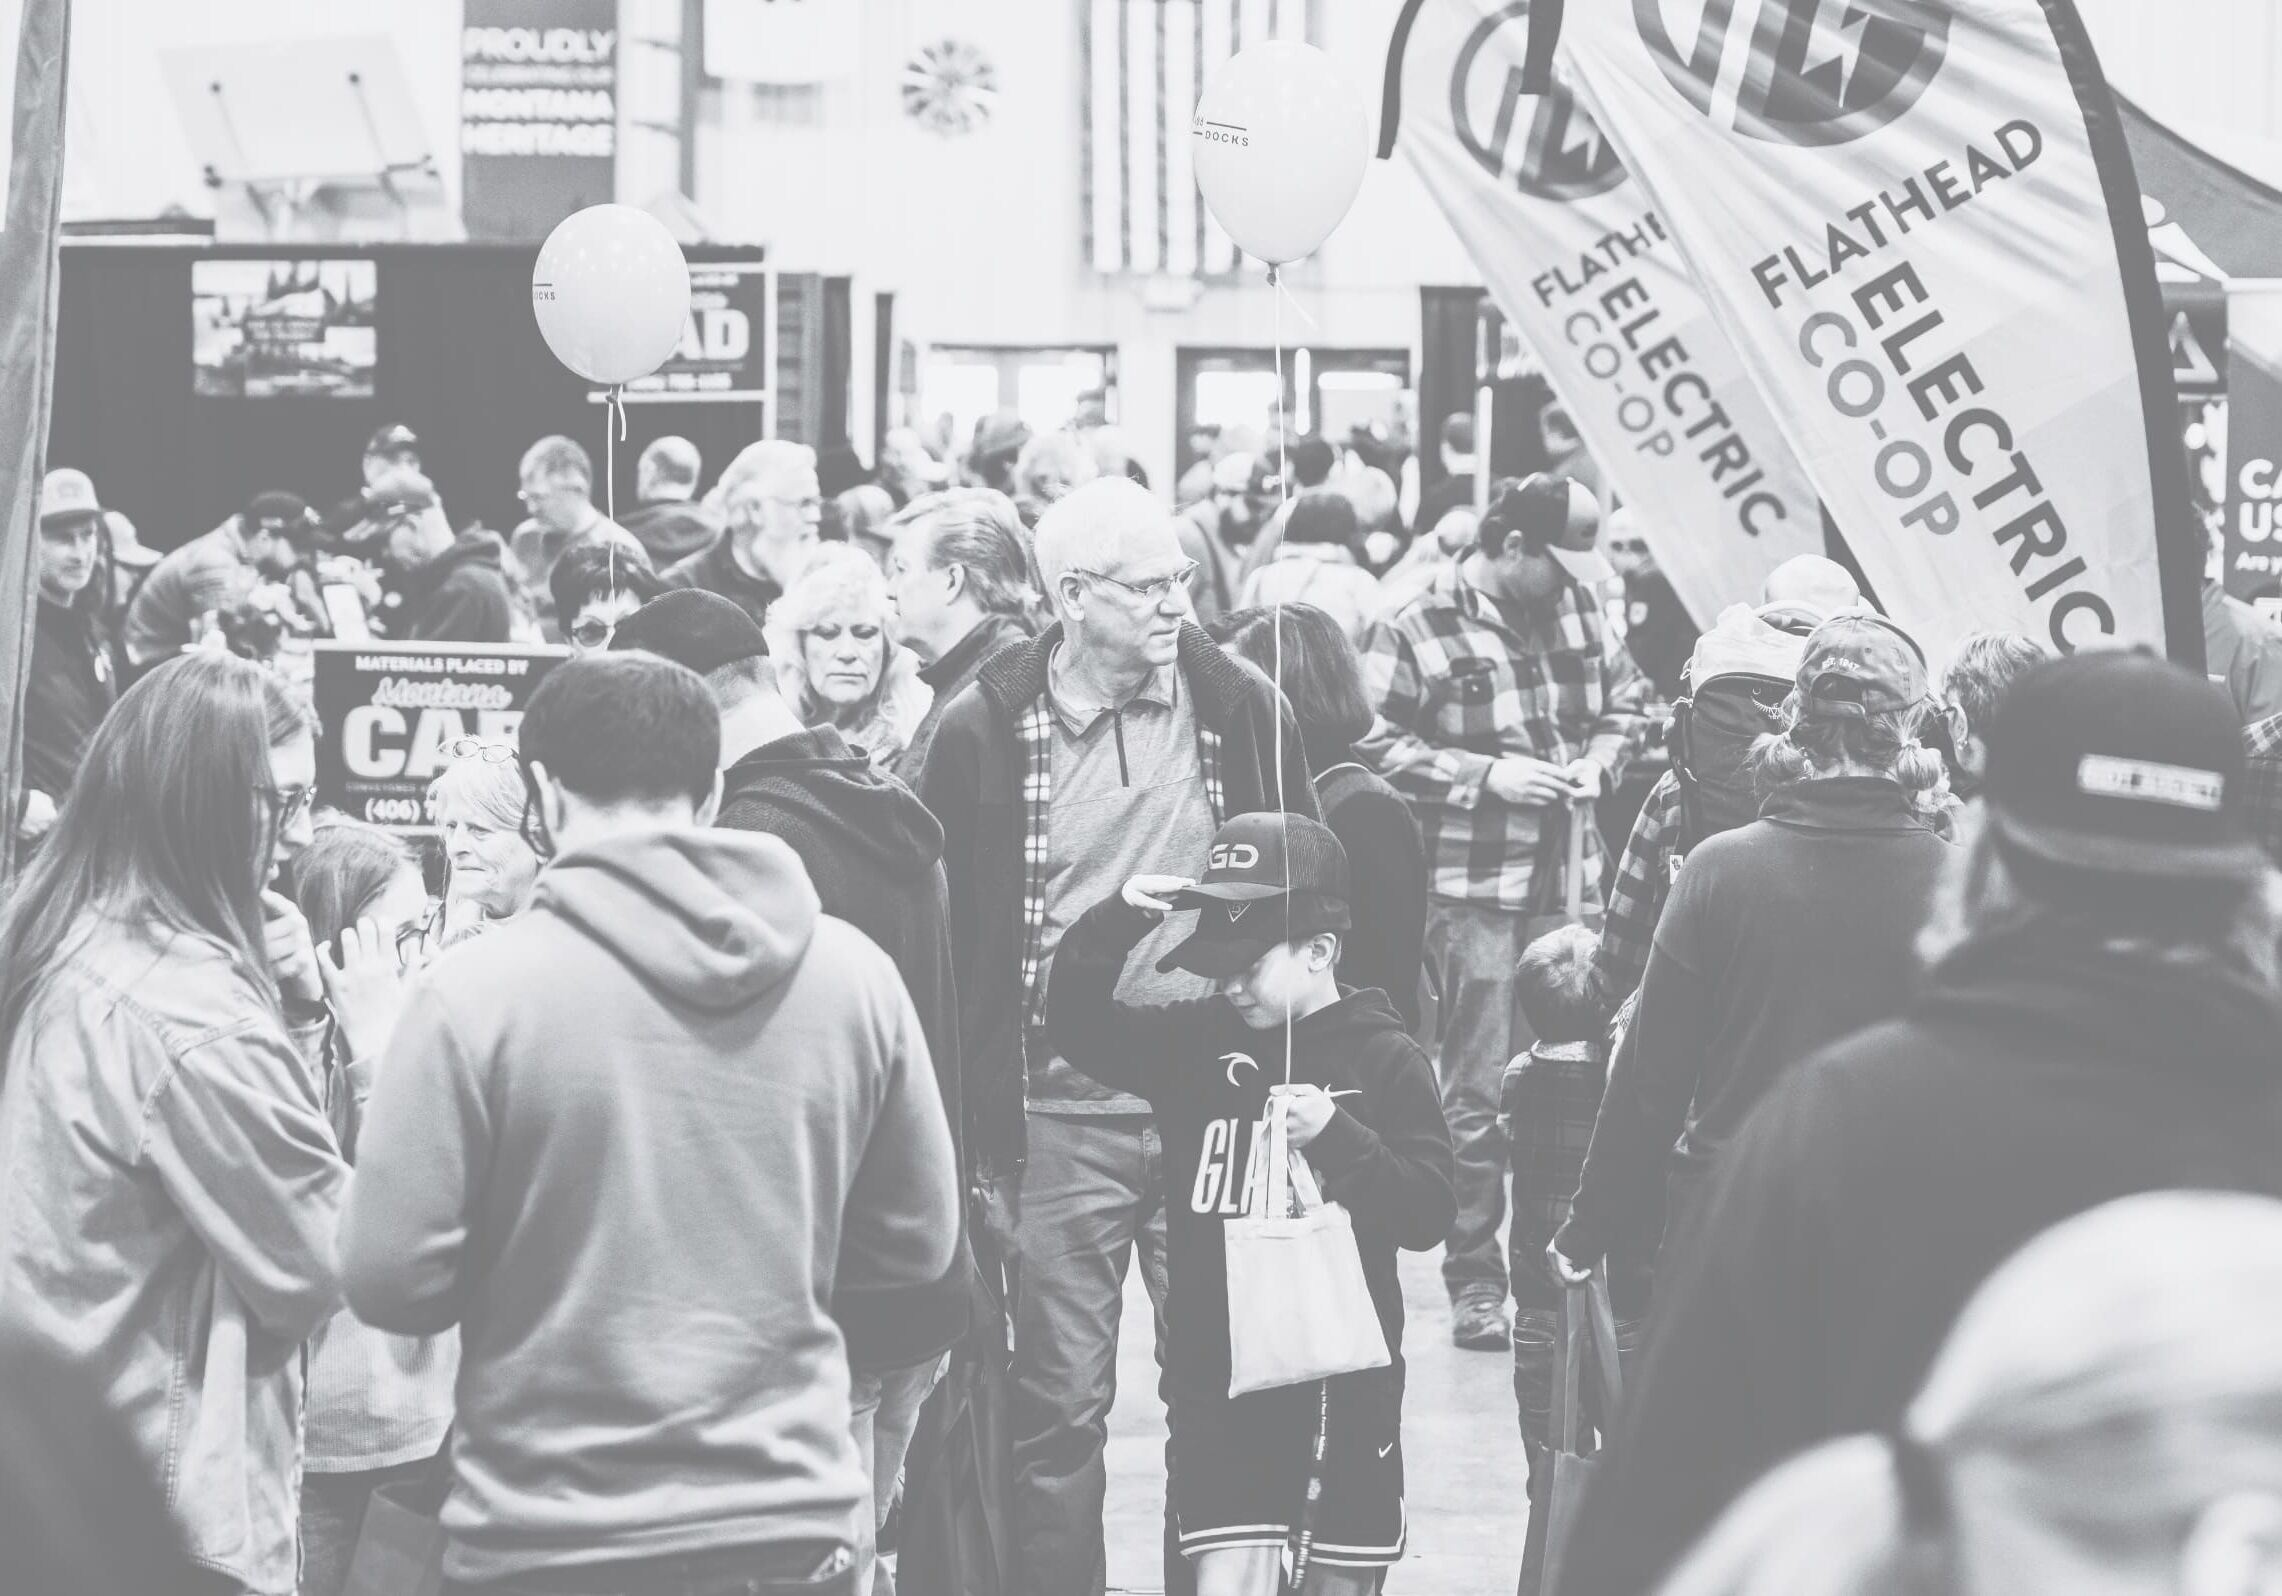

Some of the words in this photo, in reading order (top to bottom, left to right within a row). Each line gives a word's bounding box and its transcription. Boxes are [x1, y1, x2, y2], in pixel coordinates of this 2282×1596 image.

[462, 26, 617, 63] PROUDLY
[461, 87, 615, 121] MONTANA
[1205, 130, 1249, 147] DOCKS
[1750, 118, 2043, 310] FLATHEAD
[664, 308, 750, 361] AD
[1564, 311, 1675, 457] CO-OP
[1599, 276, 1788, 538] ELECTRIC
[1799, 311, 1960, 536] CO-OP
[1850, 260, 2116, 657] ELECTRIC
[355, 655, 445, 673] MATERIALS
[446, 657, 506, 675] PLACED
[507, 659, 529, 675] BY
[370, 675, 514, 710] Montana
[364, 796, 422, 825] (406)
